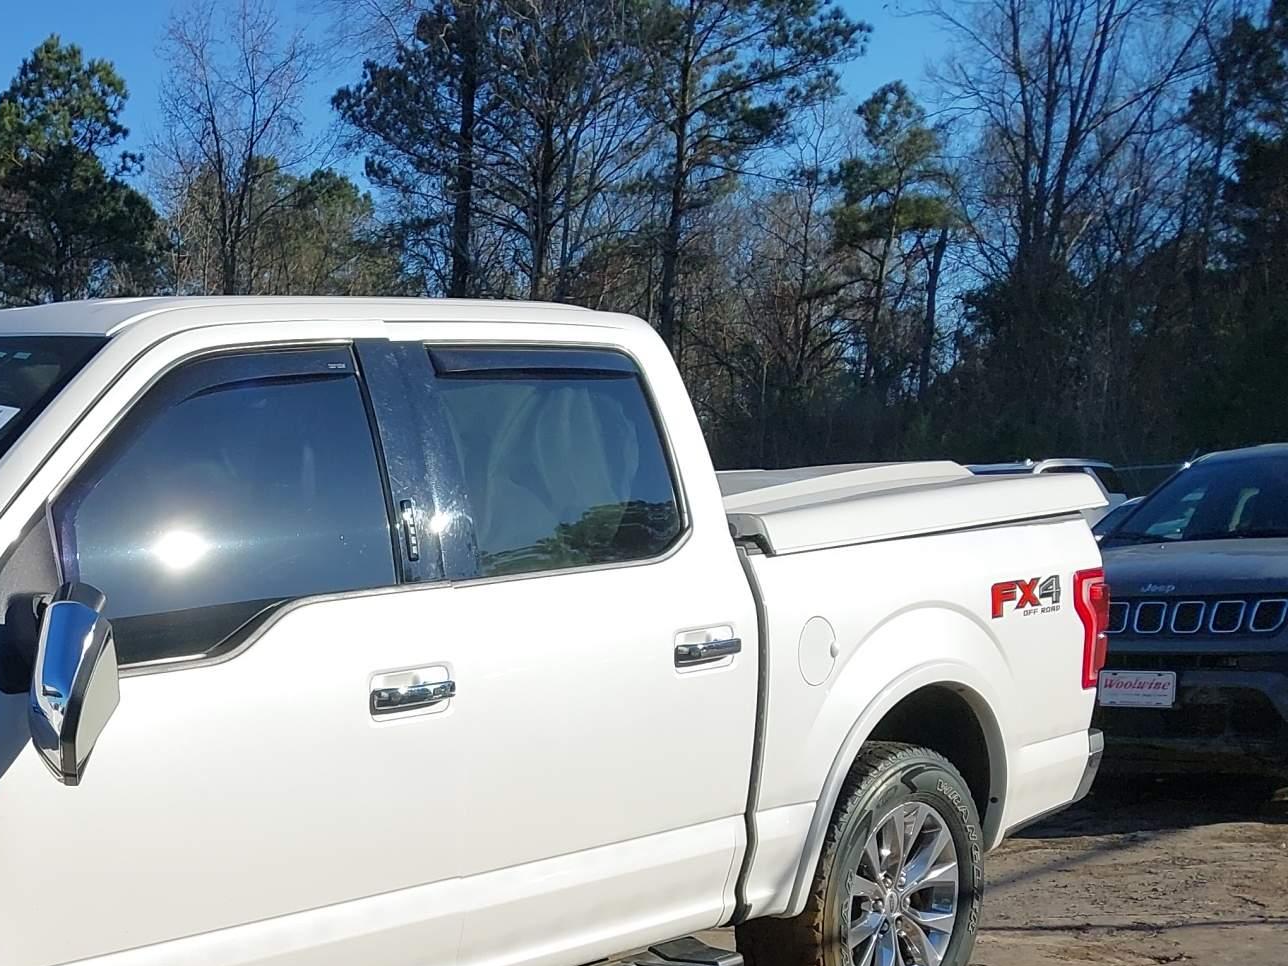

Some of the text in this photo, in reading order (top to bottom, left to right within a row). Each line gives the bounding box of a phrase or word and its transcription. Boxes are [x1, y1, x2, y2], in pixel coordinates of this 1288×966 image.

[1142, 583, 1176, 593] Jeep
[991, 574, 1061, 619] FX4
[1023, 605, 1061, 616] OFF ROAD
[1103, 677, 1171, 690] Woolwine
[936, 778, 982, 935] WRANGLER
